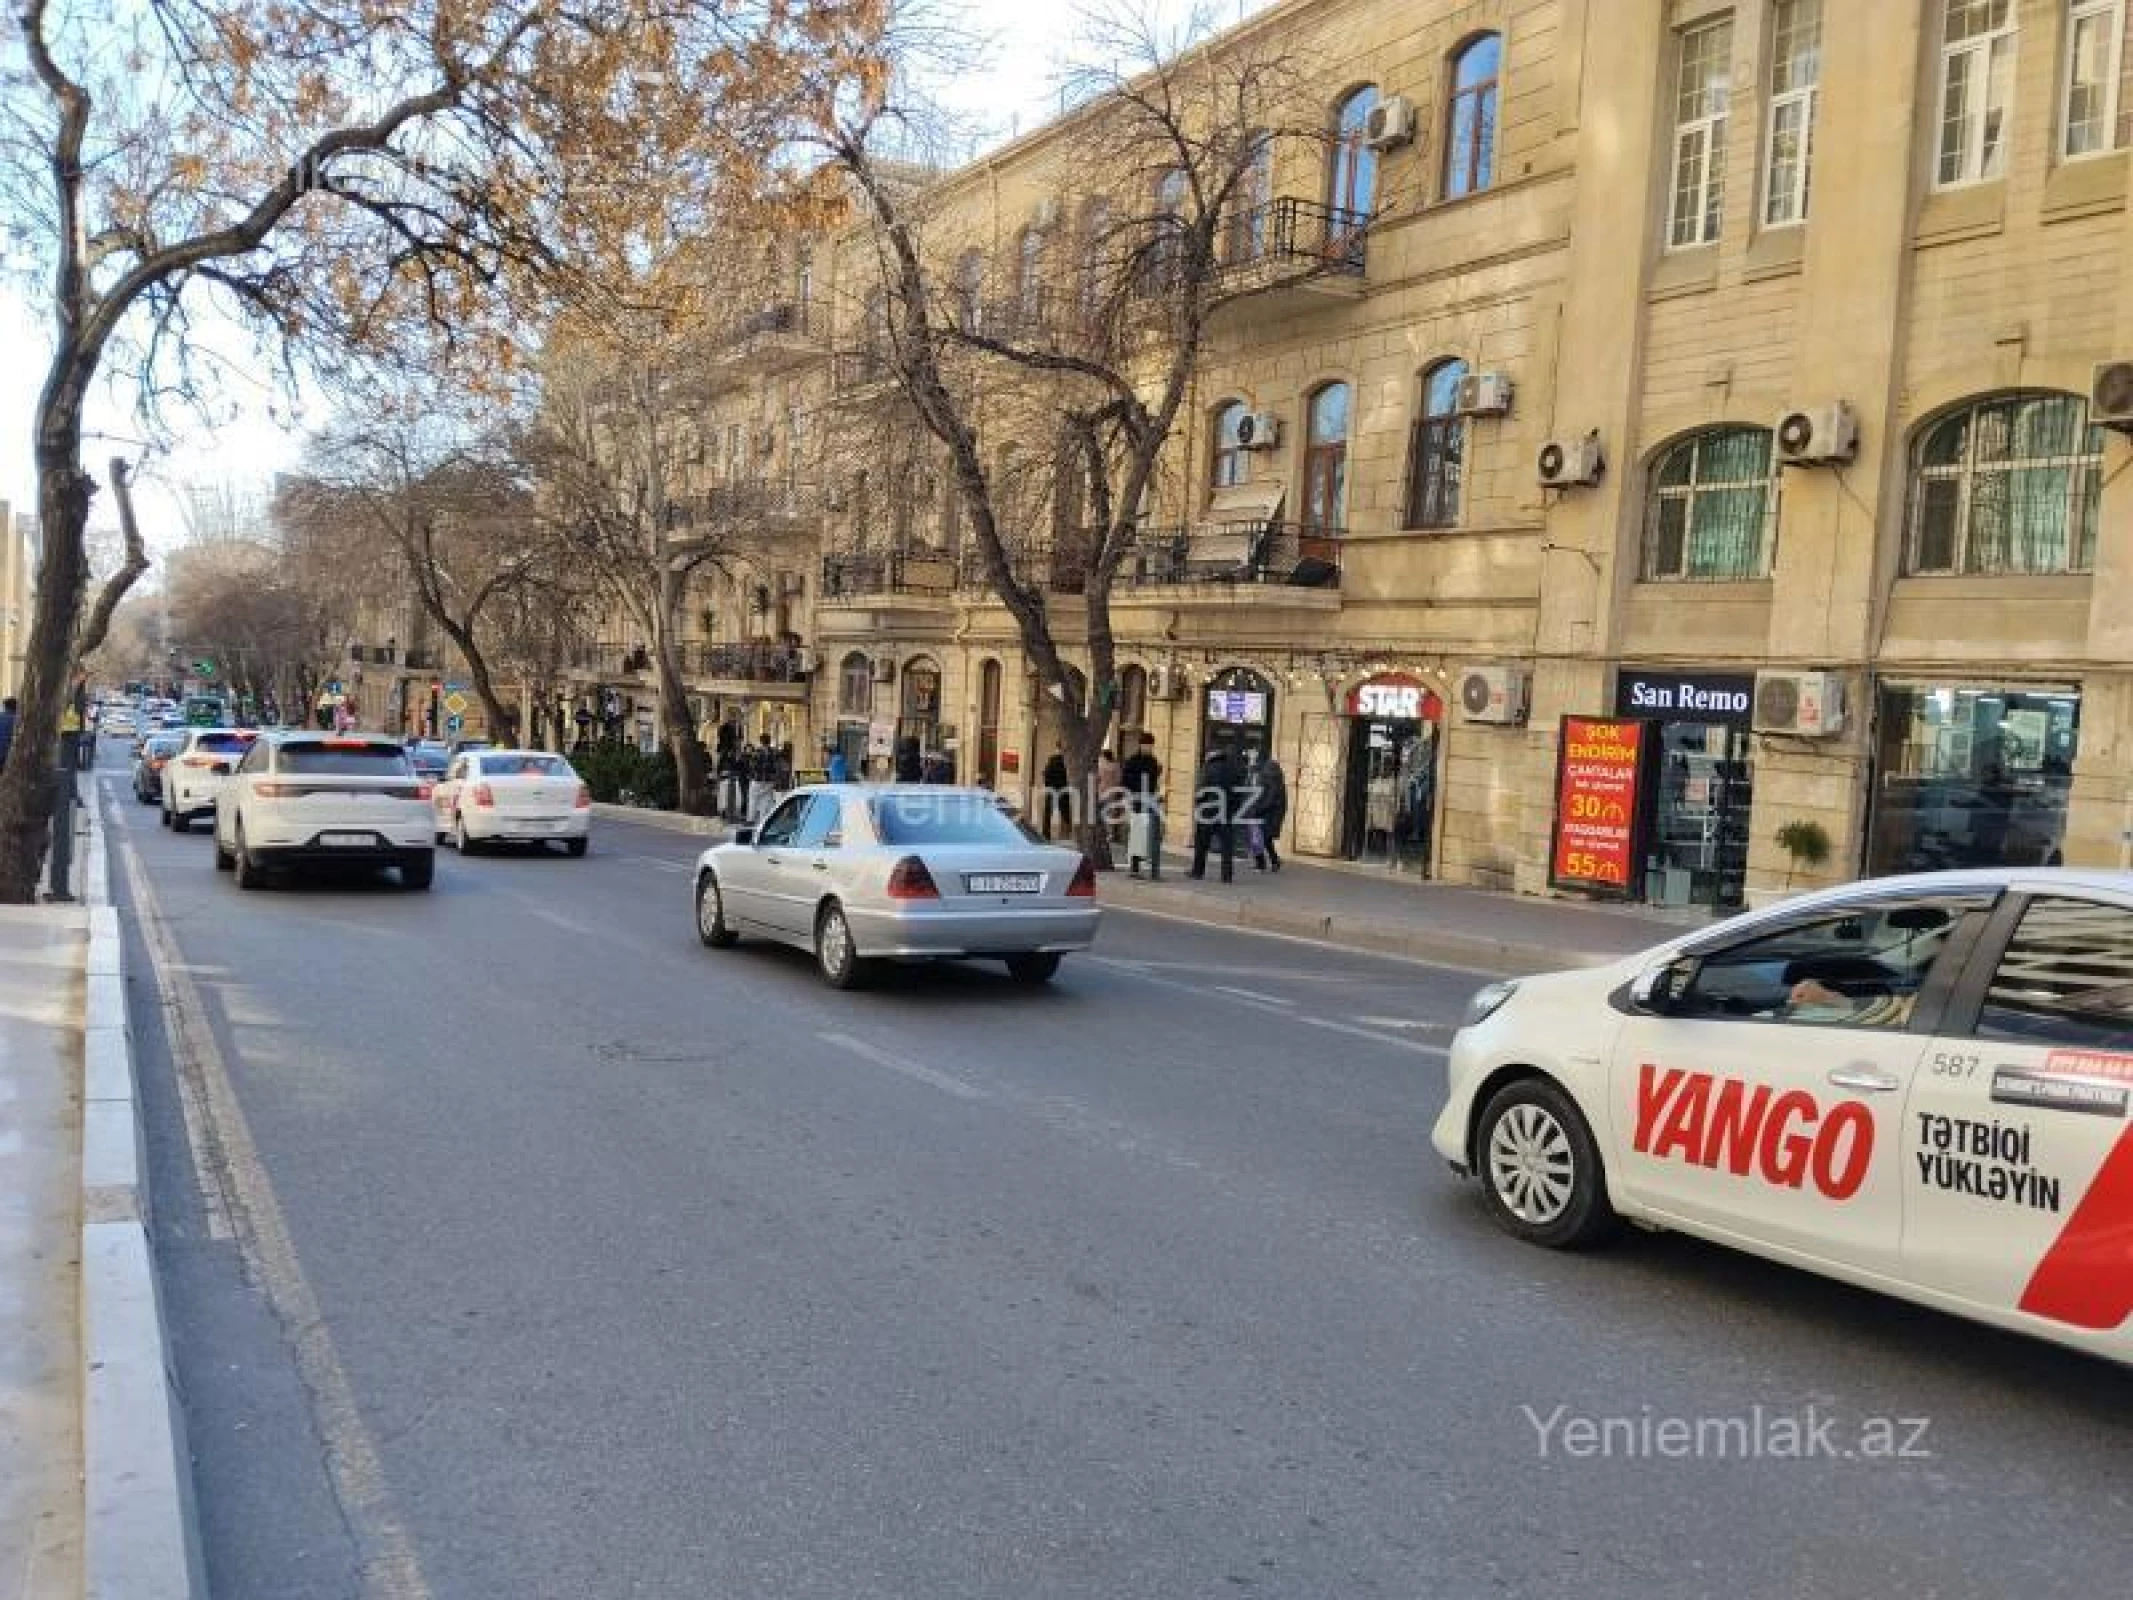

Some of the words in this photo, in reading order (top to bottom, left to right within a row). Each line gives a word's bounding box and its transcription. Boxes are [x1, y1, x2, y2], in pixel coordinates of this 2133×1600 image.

[1357, 685, 1421, 718] STAR
[1631, 682, 1673, 707] San
[1679, 684, 1749, 713] Remo
[1932, 1053, 1979, 1077] 587
[1633, 1063, 1875, 1201] YANGO
[1919, 1112, 2031, 1165] TƏTBİQİ
[1917, 1152, 2059, 1212] YÜKLƏYİN
